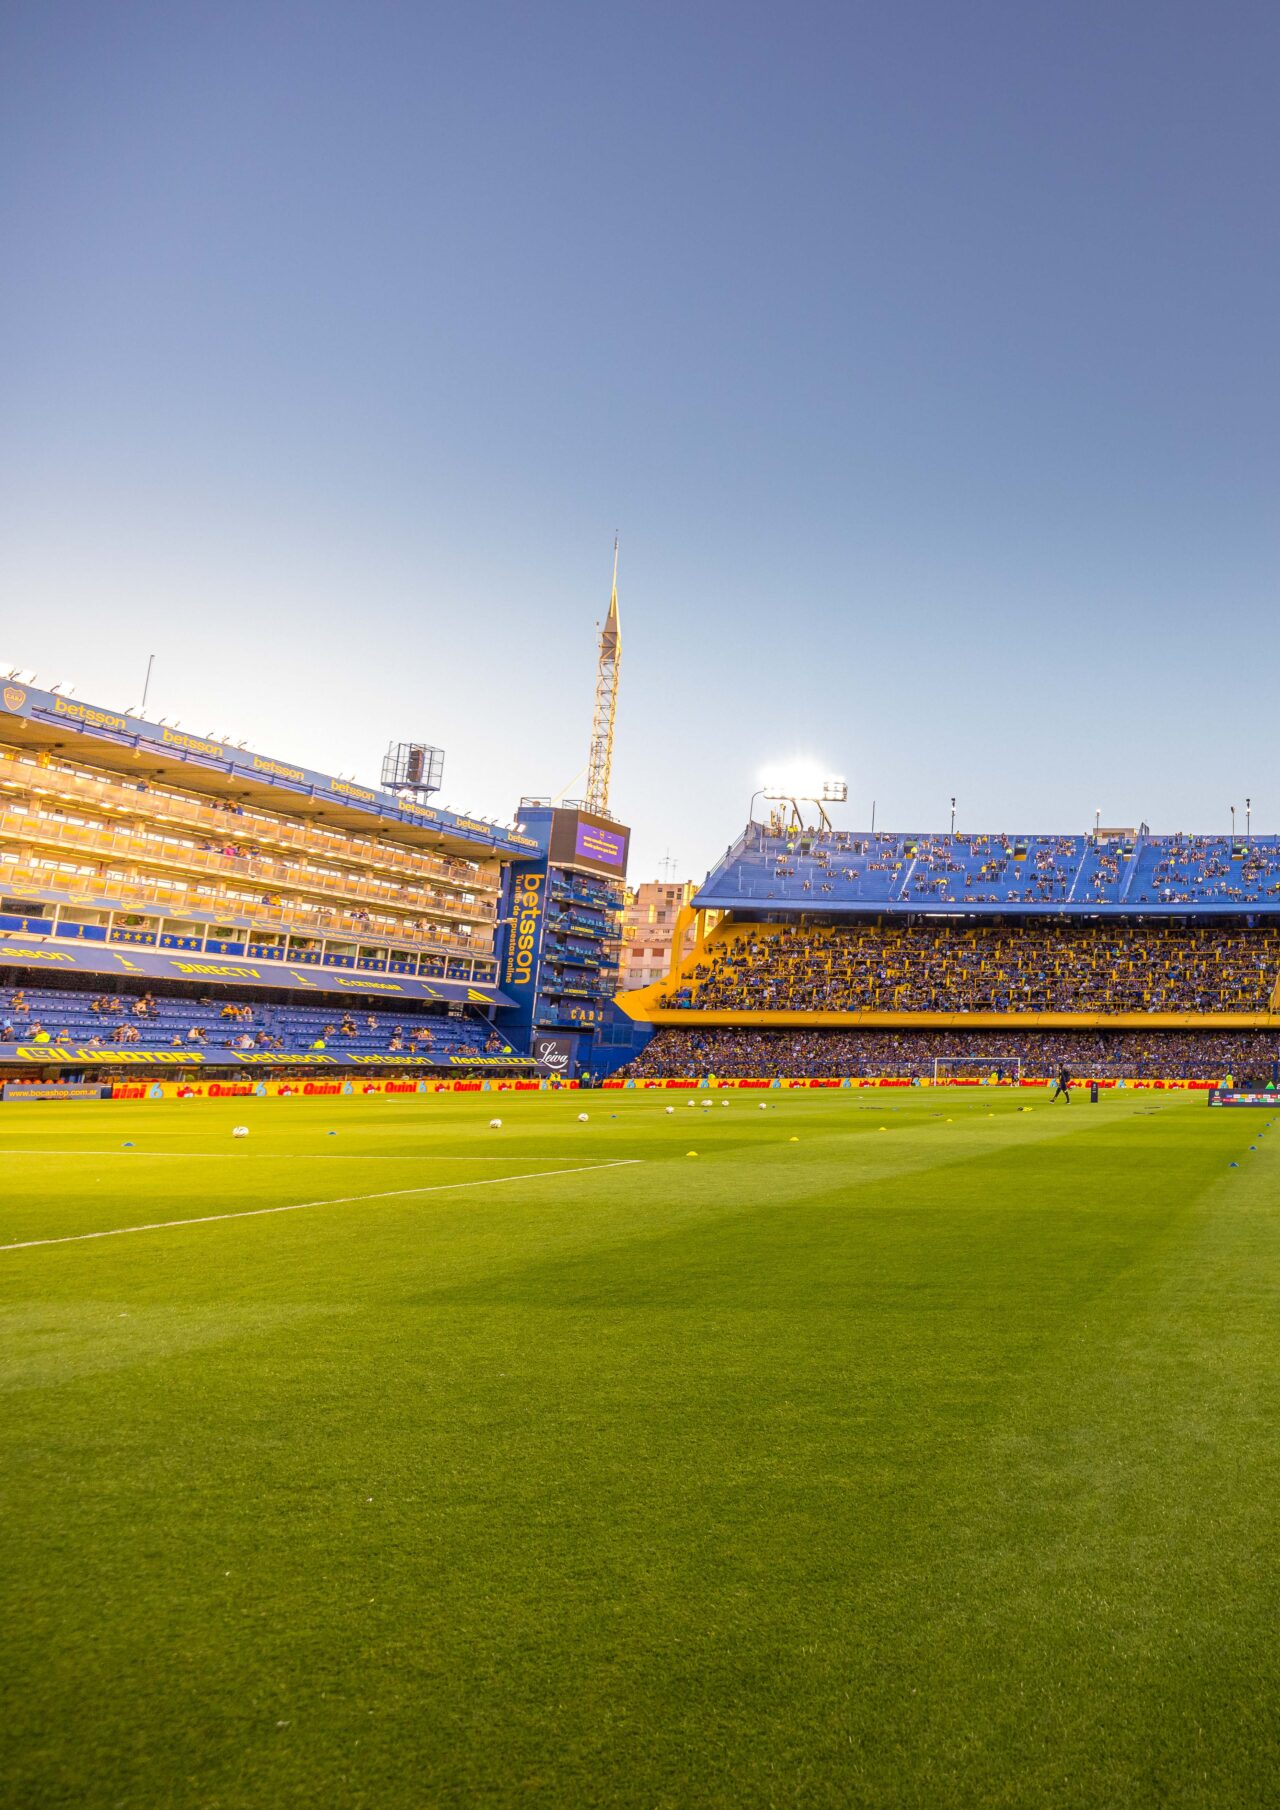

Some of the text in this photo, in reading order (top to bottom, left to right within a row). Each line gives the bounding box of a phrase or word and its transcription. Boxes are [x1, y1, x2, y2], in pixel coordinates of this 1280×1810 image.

[55, 698, 126, 730] betsson
[163, 728, 223, 757] betsson
[253, 755, 304, 780] betsson
[331, 779, 375, 801] betsson
[399, 800, 437, 819] betsson
[456, 817, 490, 834] betsson
[507, 832, 539, 848] betsson
[514, 873, 545, 984] betsson
[170, 961, 261, 979] DIRECTV
[505, 957, 514, 984] online
[231, 1051, 338, 1063] betsson
[347, 1053, 434, 1065] betsson
[207, 1083, 253, 1097] Quini
[303, 1082, 342, 1095] Quini
[384, 1081, 417, 1093] Quini
[453, 1081, 482, 1092] Quini
[514, 1080, 541, 1091] Quini
[665, 1080, 699, 1089] Quini
[738, 1080, 771, 1089] Quini
[8, 1087, 98, 1098] www.bocashop.com.ar
